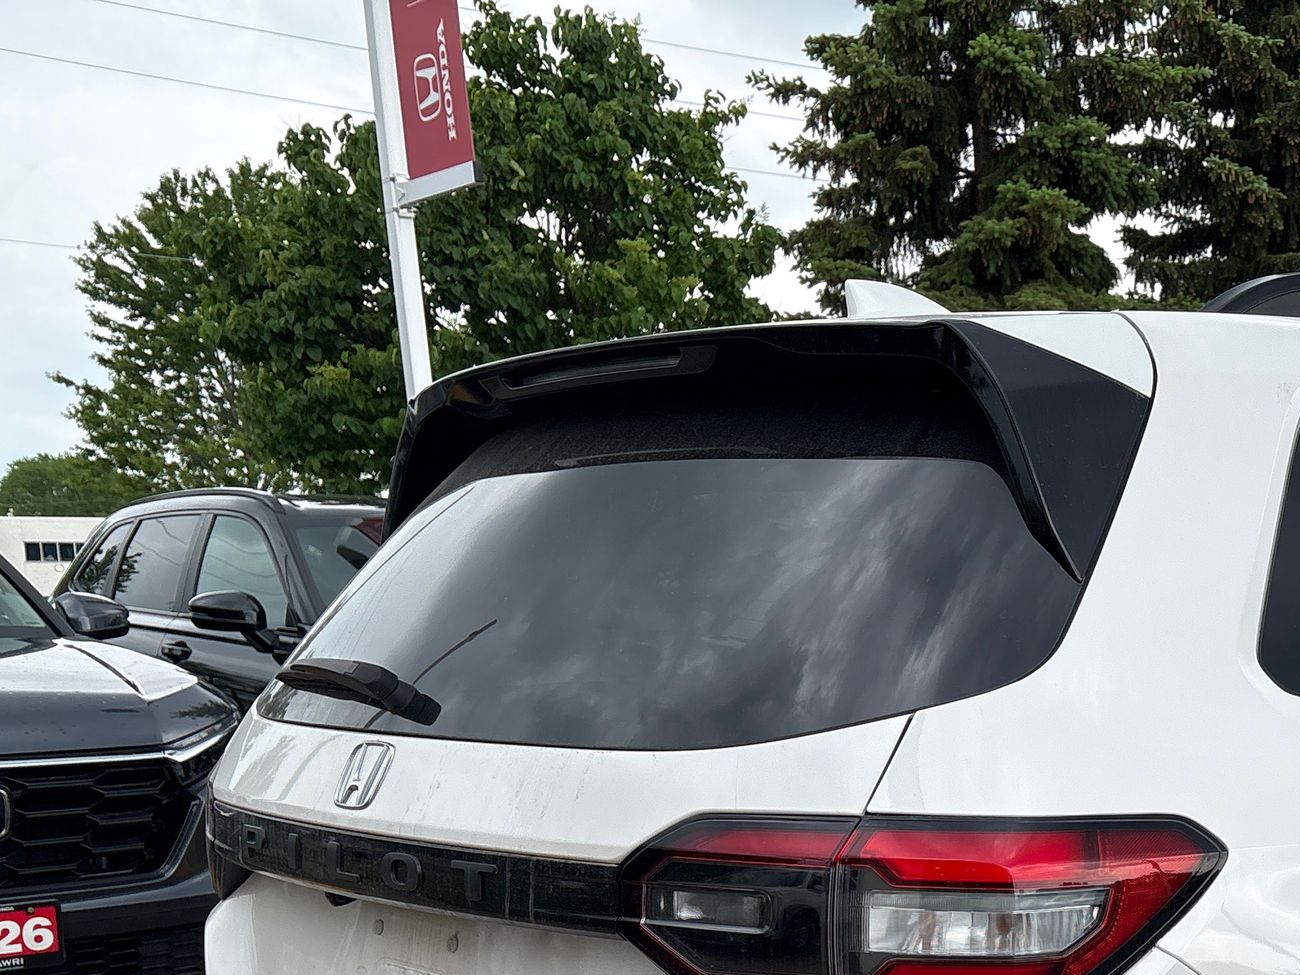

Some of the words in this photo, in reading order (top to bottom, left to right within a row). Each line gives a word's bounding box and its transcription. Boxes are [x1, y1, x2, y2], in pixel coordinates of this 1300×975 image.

[436, 17, 457, 141] HONDA
[242, 823, 498, 901] PILOT
[0, 917, 54, 954] 26
